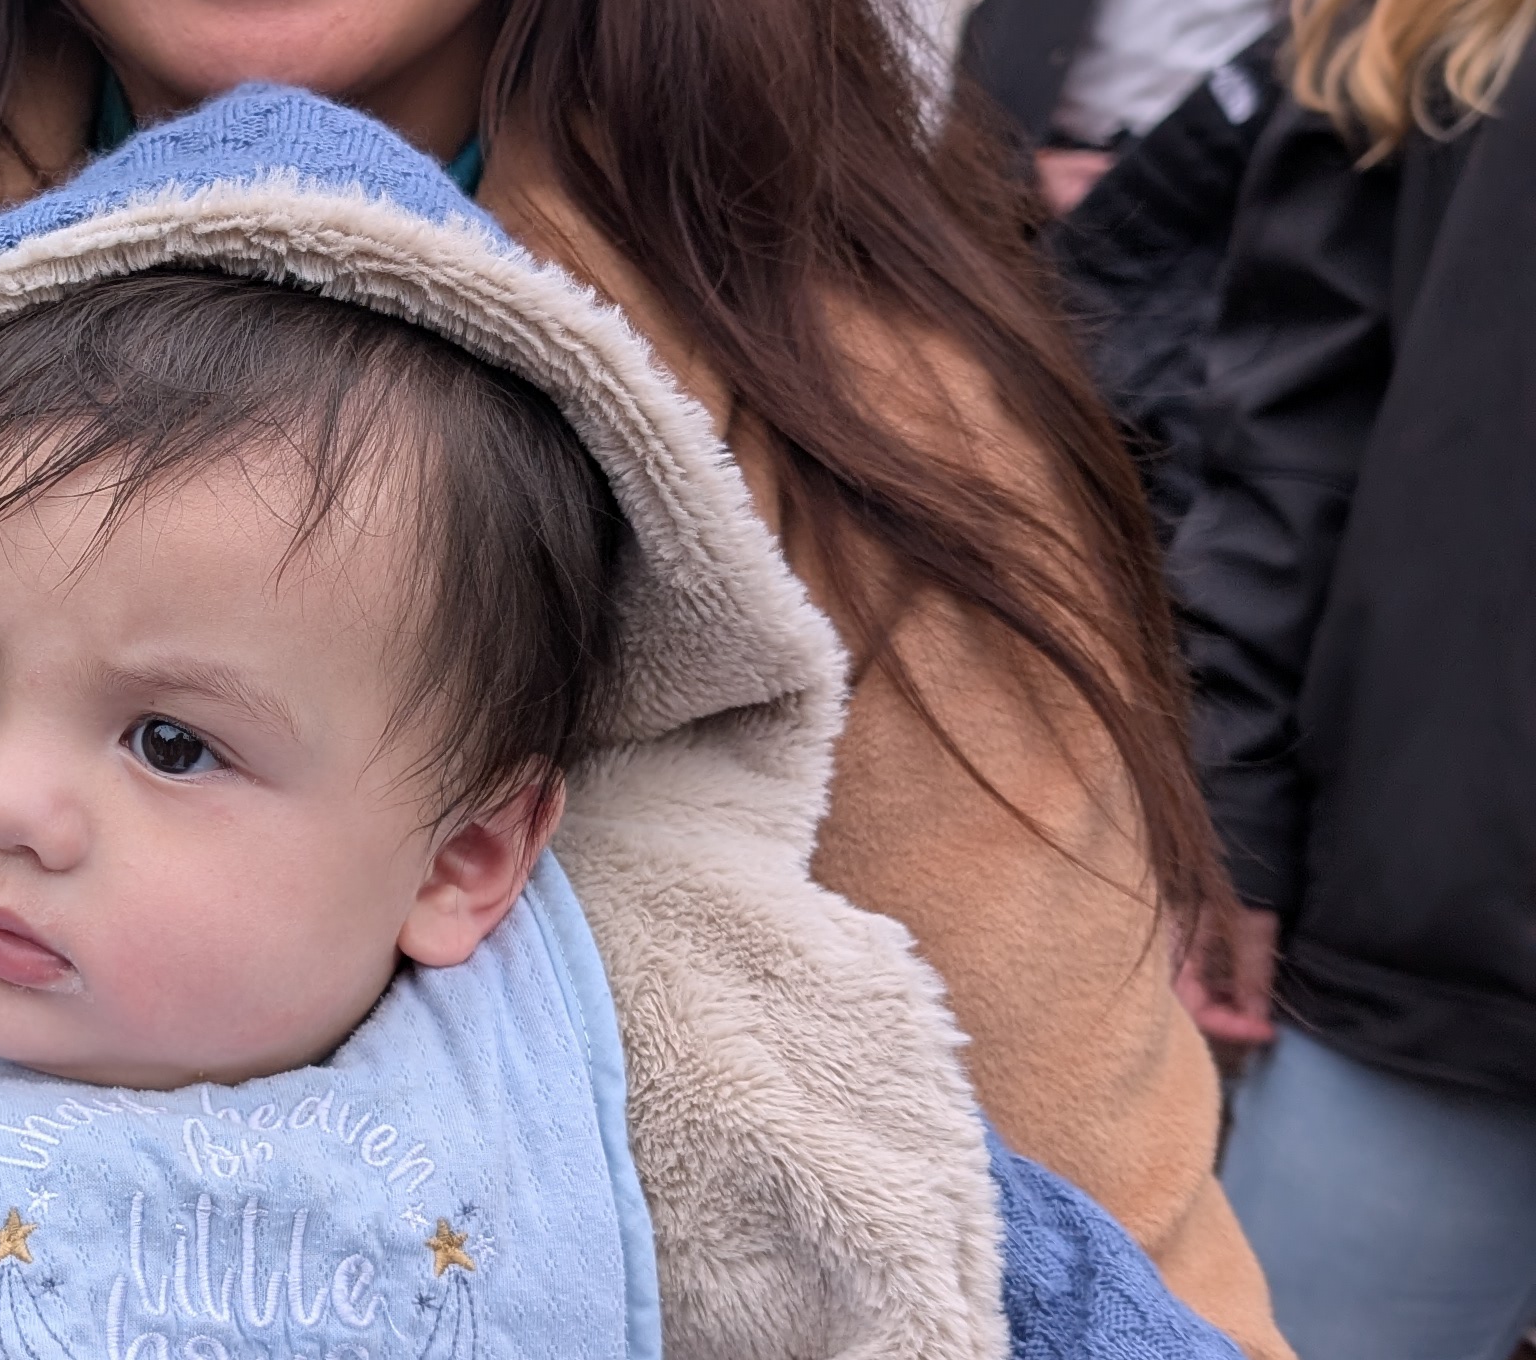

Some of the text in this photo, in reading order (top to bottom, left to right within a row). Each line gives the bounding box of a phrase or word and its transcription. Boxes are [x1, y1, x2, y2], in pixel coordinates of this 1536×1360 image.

[179, 1118, 274, 1178] for
[200, 1085, 435, 1193] heaven
[129, 1192, 384, 1327] little
